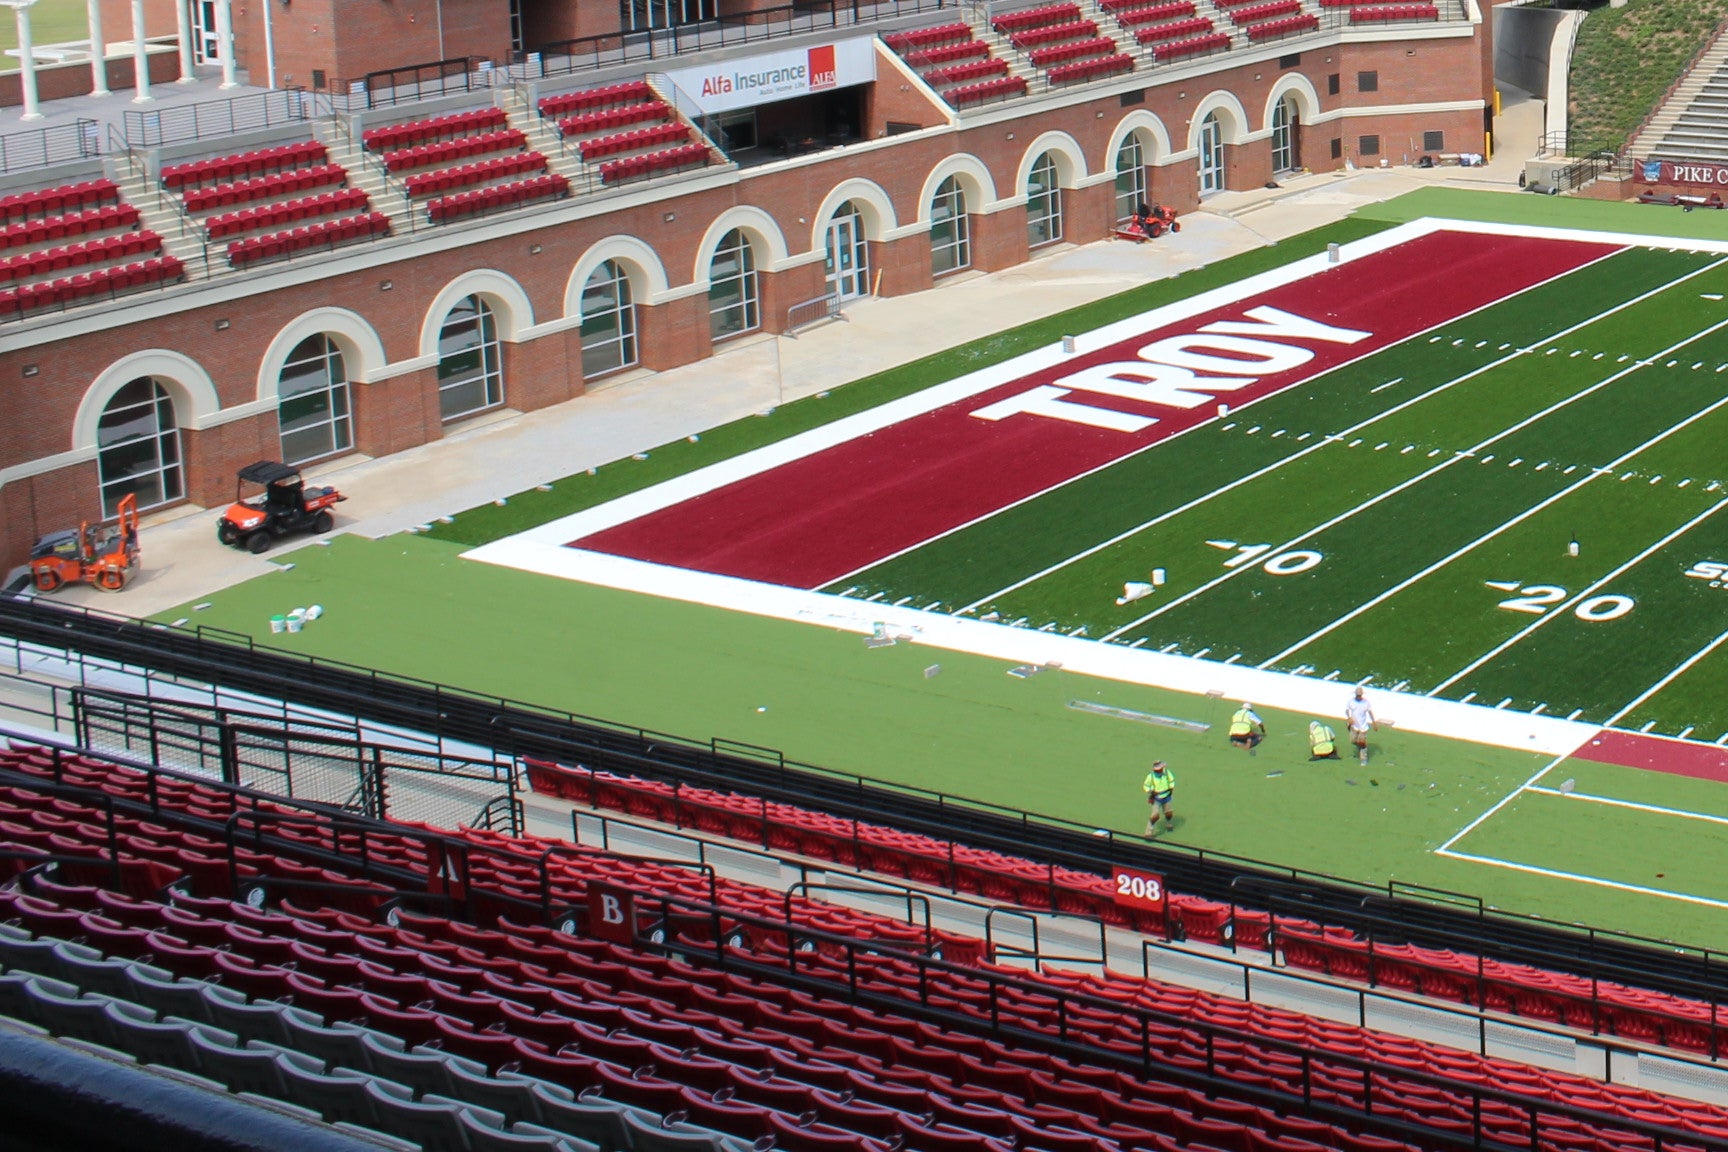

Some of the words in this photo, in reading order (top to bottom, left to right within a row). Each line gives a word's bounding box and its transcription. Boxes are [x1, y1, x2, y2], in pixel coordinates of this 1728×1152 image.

[701, 75, 732, 97] Alfa
[734, 64, 806, 90] Insurance
[811, 71, 835, 86] ALFA
[1673, 165, 1713, 183] PIKE
[969, 305, 1373, 433] TROY
[1117, 873, 1160, 901] 208
[601, 893, 624, 925] B
